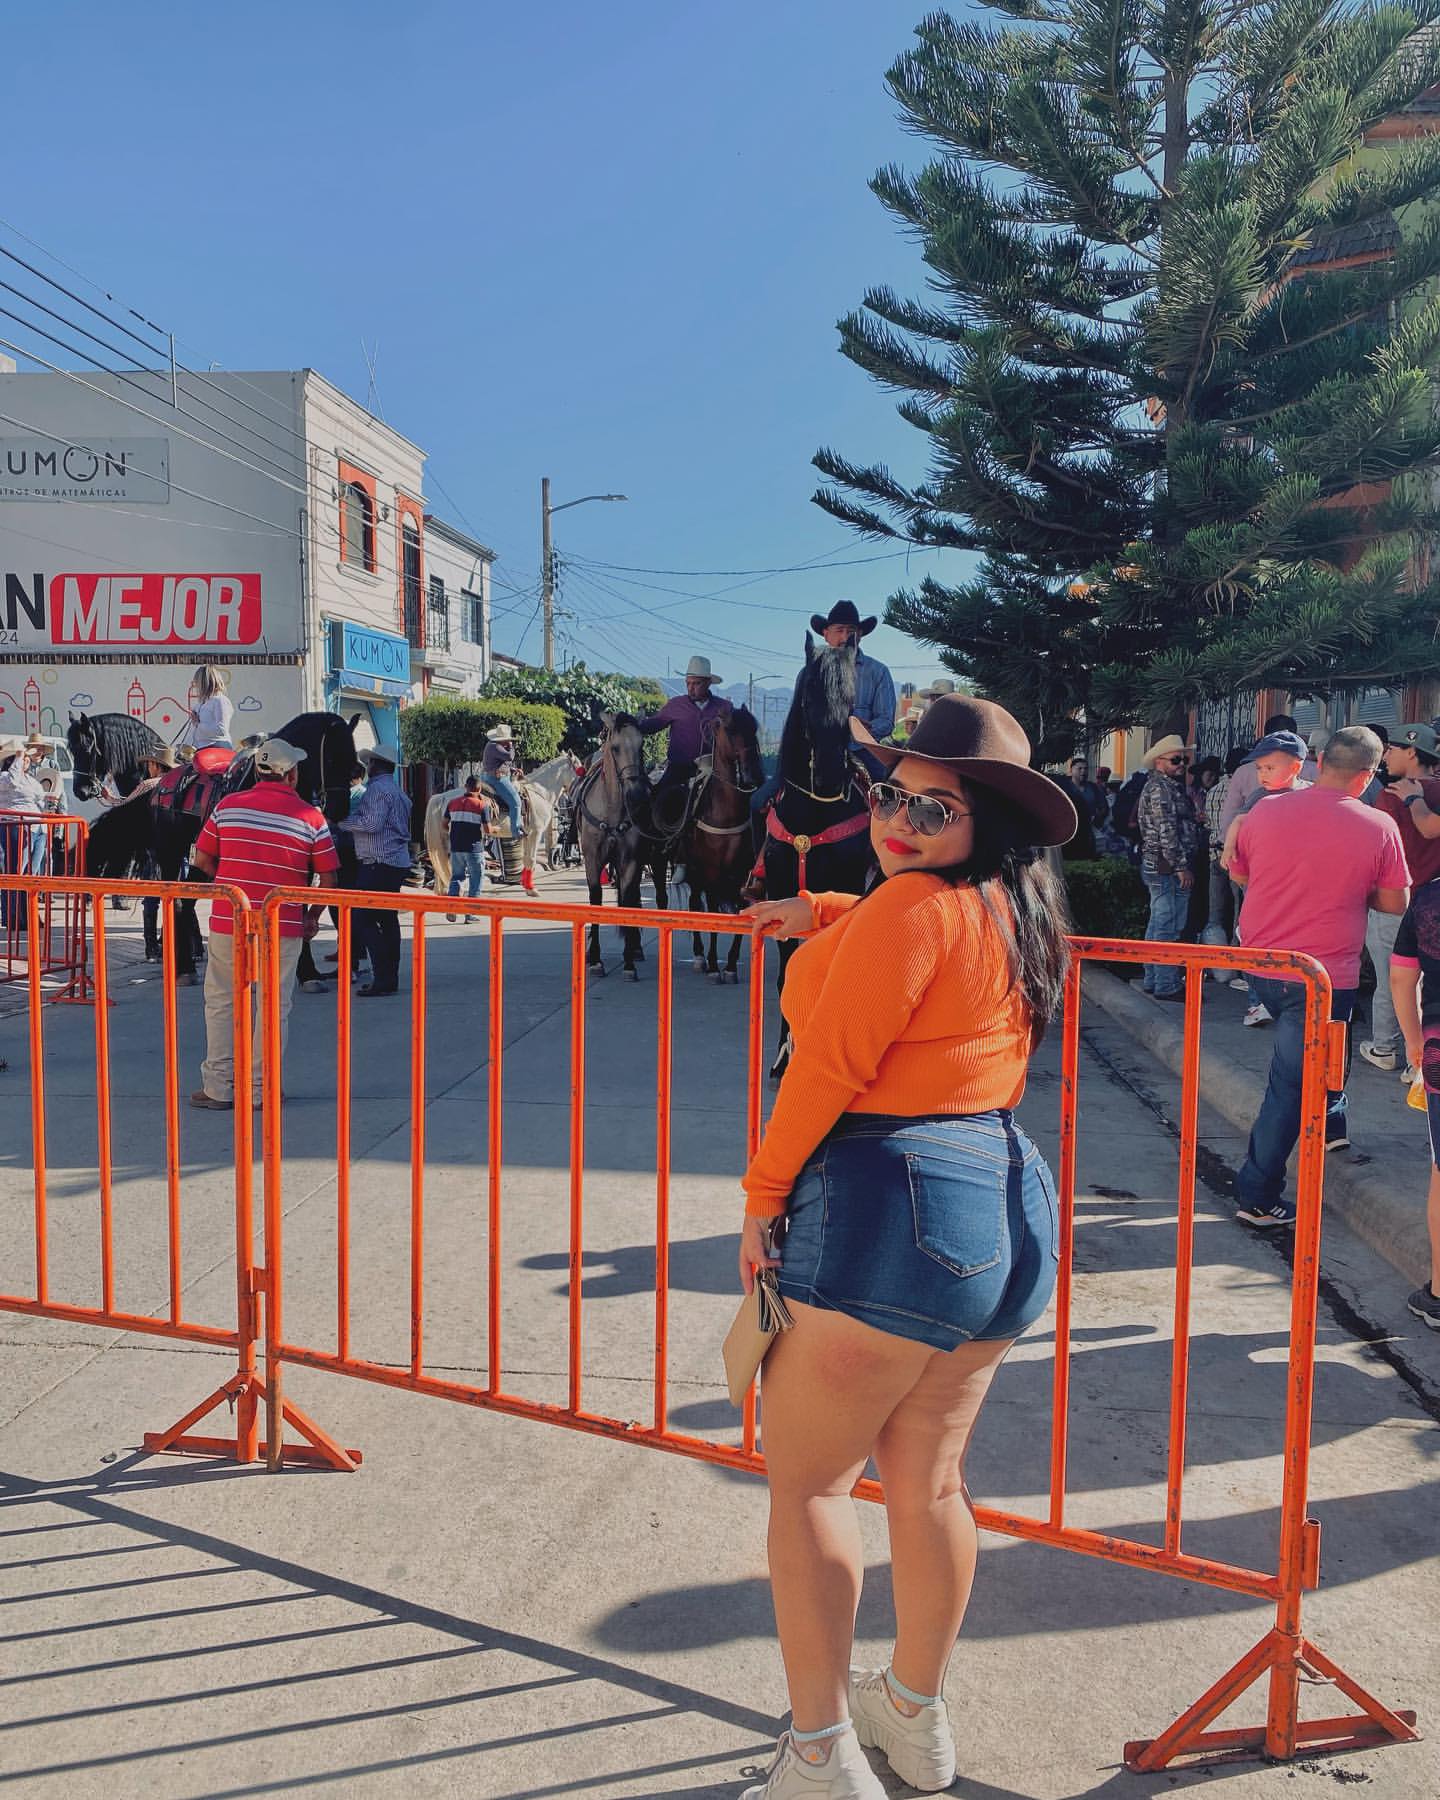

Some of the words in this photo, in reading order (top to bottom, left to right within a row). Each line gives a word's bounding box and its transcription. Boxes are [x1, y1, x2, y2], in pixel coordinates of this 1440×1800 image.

[0, 446, 126, 482] UMON
[62, 576, 243, 641] MEJOR
[350, 635, 403, 673] KUMON
